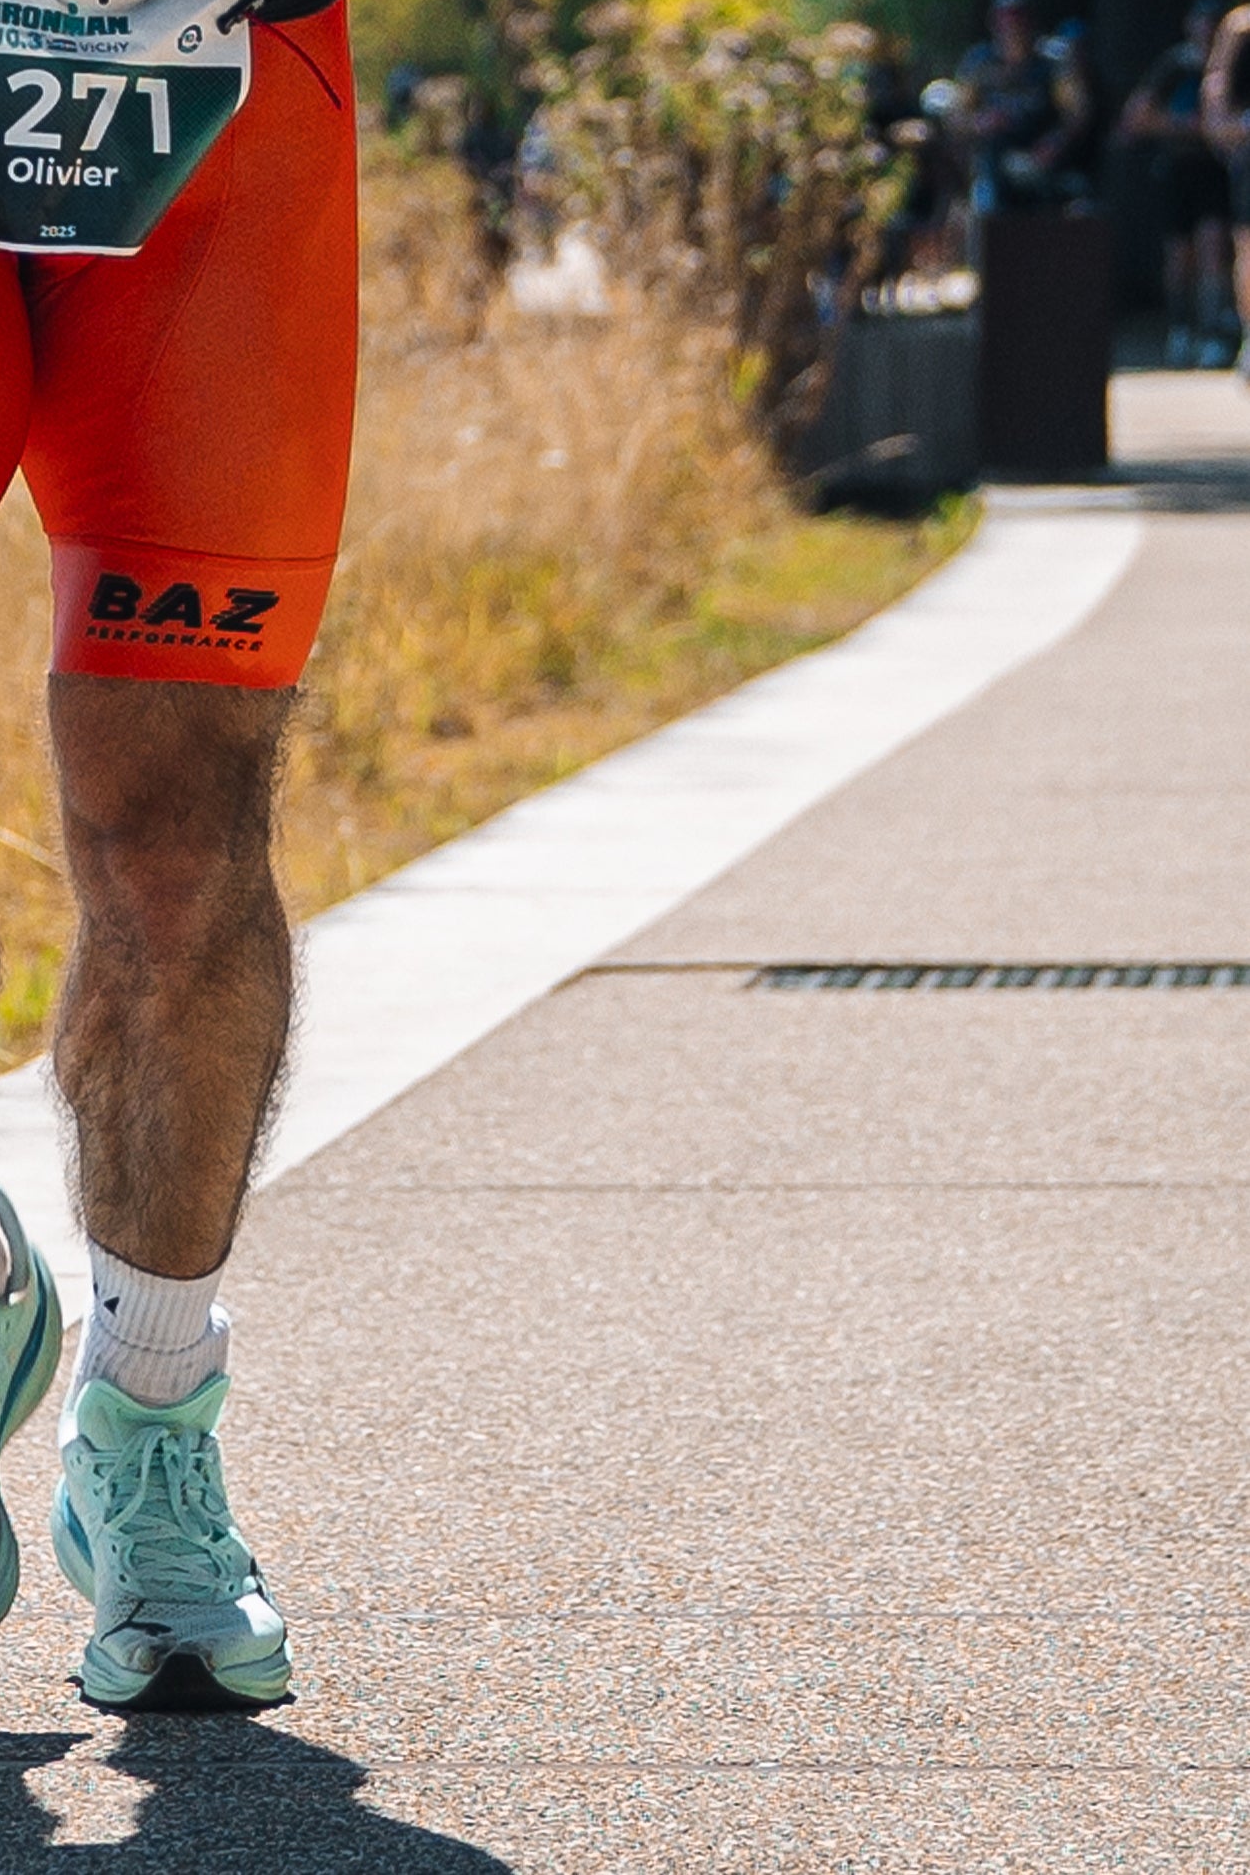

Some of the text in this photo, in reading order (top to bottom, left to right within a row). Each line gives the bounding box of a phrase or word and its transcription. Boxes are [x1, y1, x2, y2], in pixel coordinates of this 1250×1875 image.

[79, 41, 130, 54] VICHY
[8, 156, 119, 187] Olivier
[39, 225, 77, 238] 2025
[88, 573, 280, 634] BAZ
[85, 626, 263, 652] PERFORMANCE
